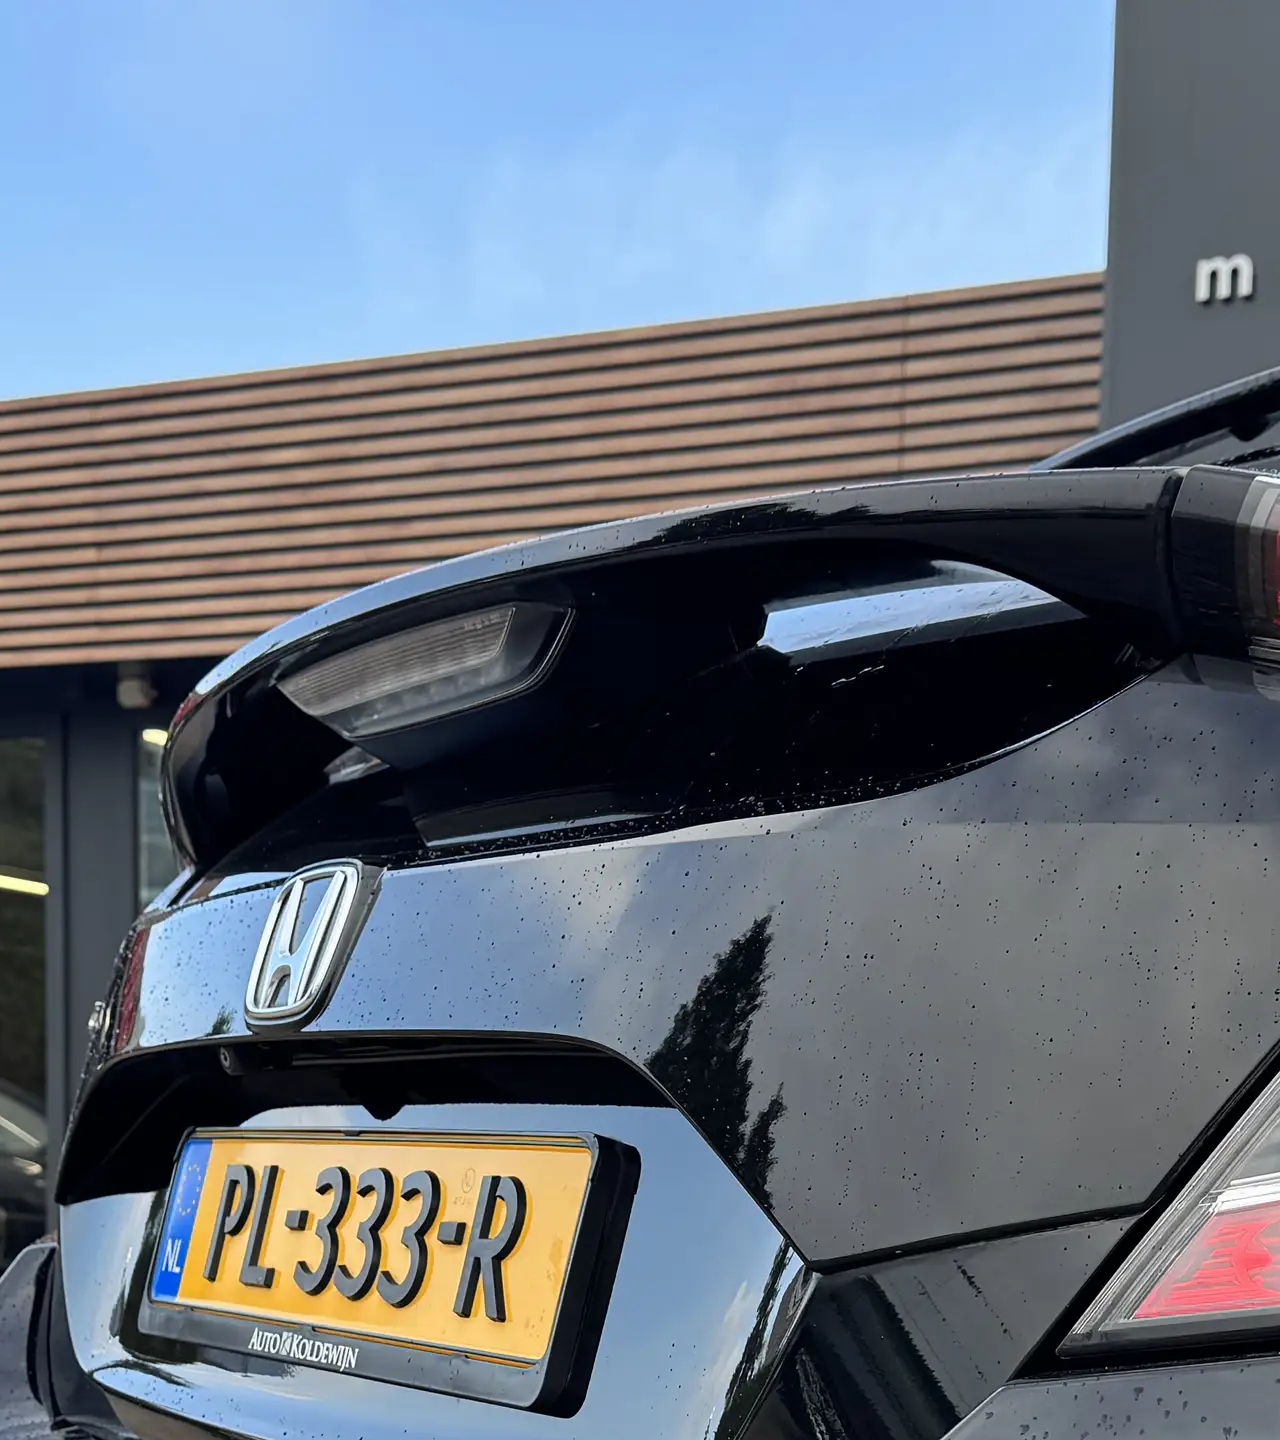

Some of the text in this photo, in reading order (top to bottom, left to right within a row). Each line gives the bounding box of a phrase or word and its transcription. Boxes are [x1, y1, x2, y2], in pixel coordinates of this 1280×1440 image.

[161, 1237, 182, 1273] NL
[202, 1163, 528, 1323] PL-333-R
[248, 1327, 280, 1354] AUTO
[289, 1333, 359, 1372] KOLDEWIJN
